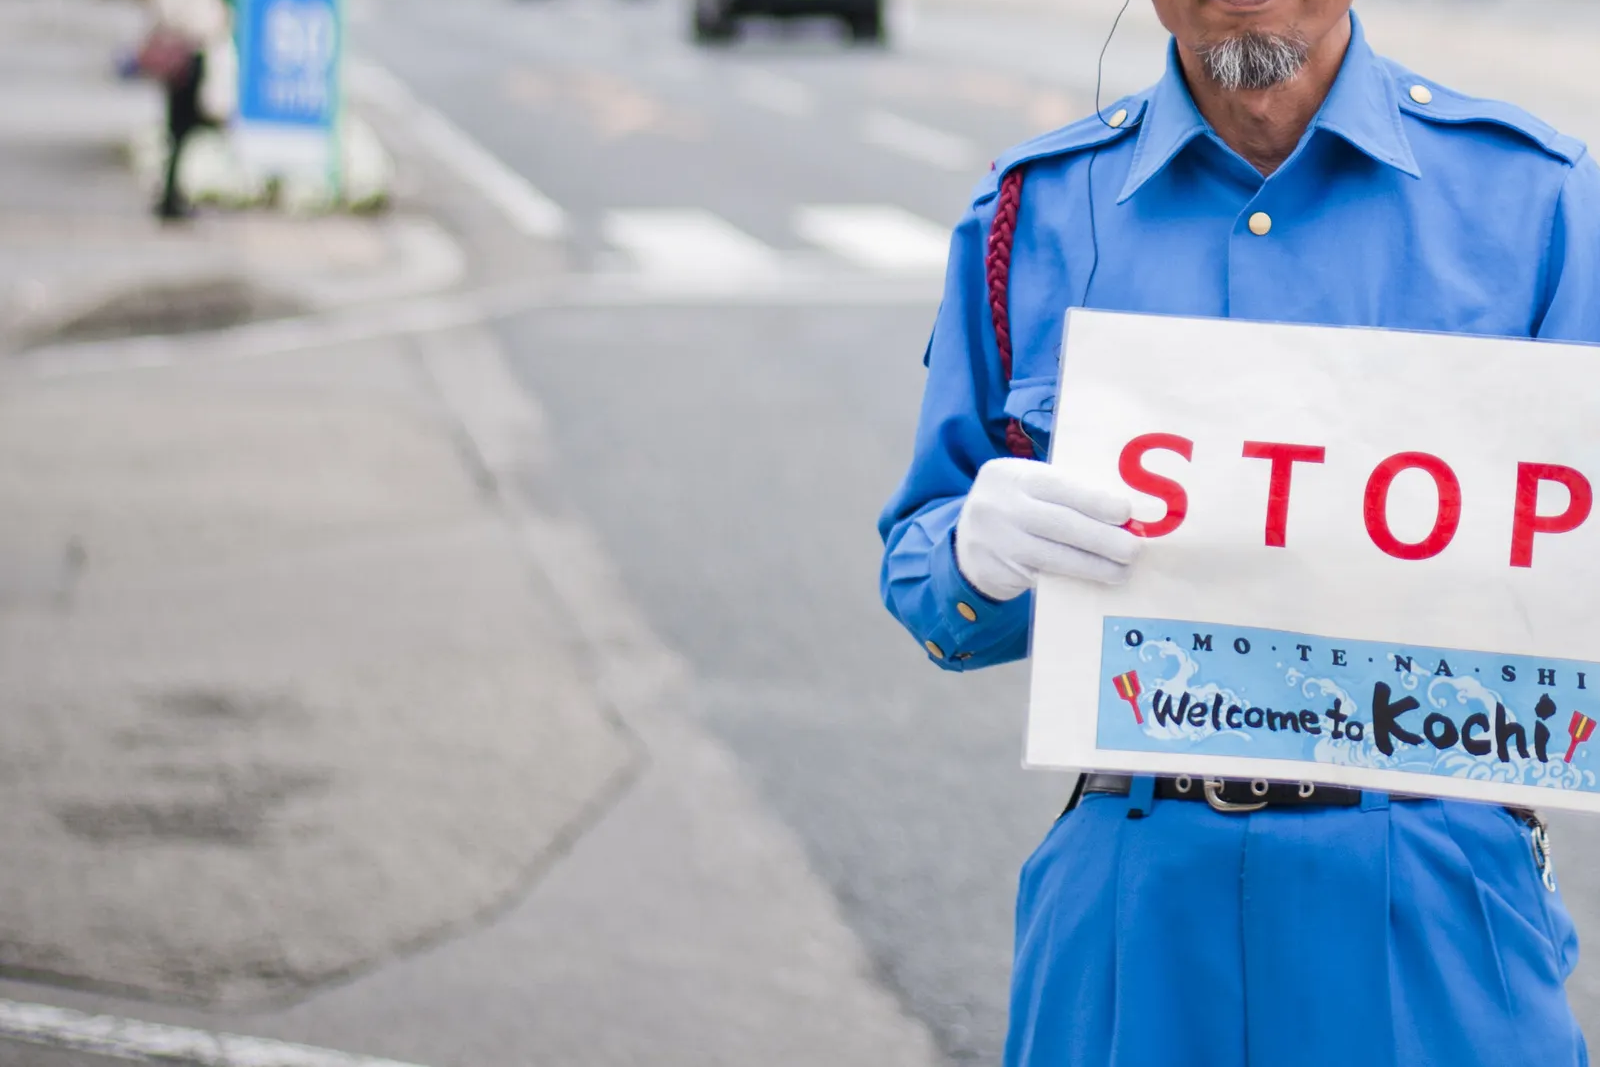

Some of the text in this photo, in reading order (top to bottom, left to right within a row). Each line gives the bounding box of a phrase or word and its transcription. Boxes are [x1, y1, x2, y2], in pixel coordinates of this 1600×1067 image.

[1119, 432, 1593, 568] STOP
[1152, 681, 1557, 764] Welcome to Kochi
